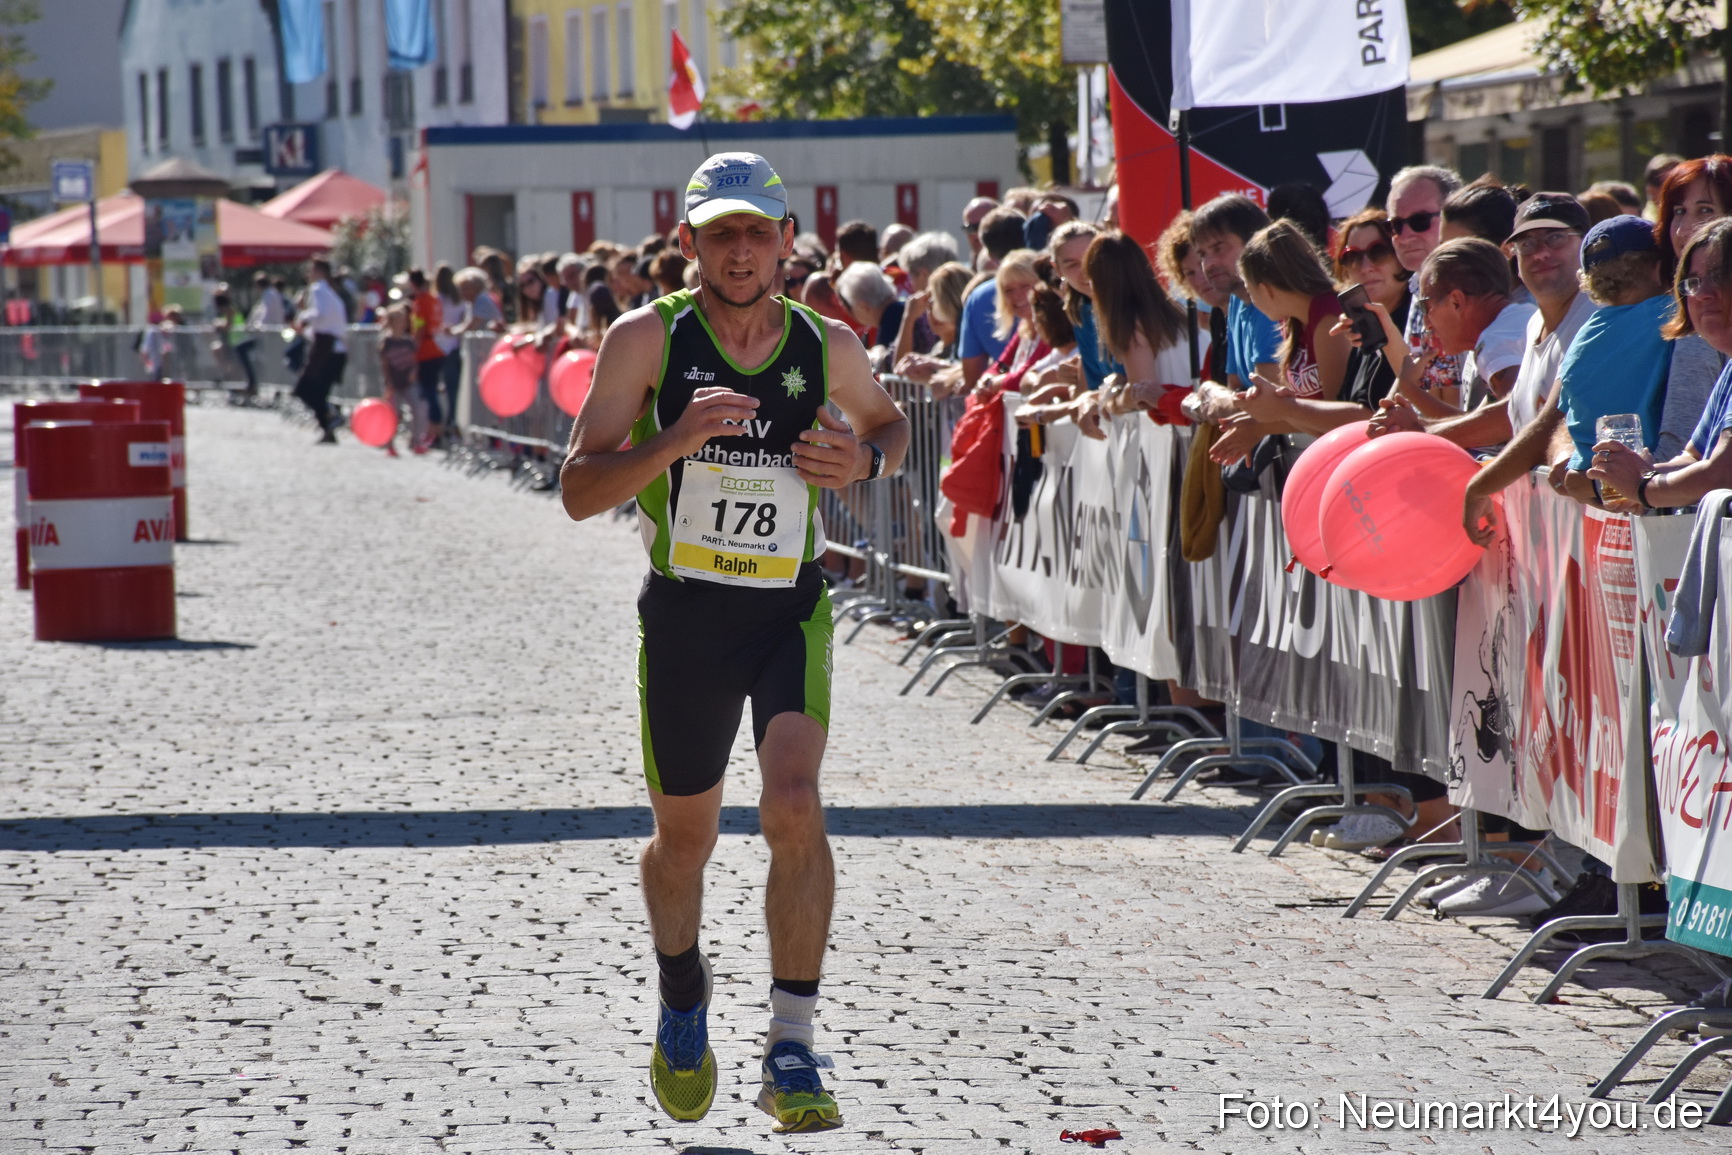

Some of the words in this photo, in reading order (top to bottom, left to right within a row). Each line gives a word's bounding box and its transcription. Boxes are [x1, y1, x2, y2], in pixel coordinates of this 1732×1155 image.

[717, 175, 750, 188] 2017
[722, 418, 772, 439] AV
[720, 476, 775, 492] BOCK
[711, 499, 777, 537] 178
[701, 534, 726, 547] PARTL
[728, 540, 766, 550] Neumarkt
[714, 554, 758, 575] Ralph
[1675, 897, 1689, 927] 0
